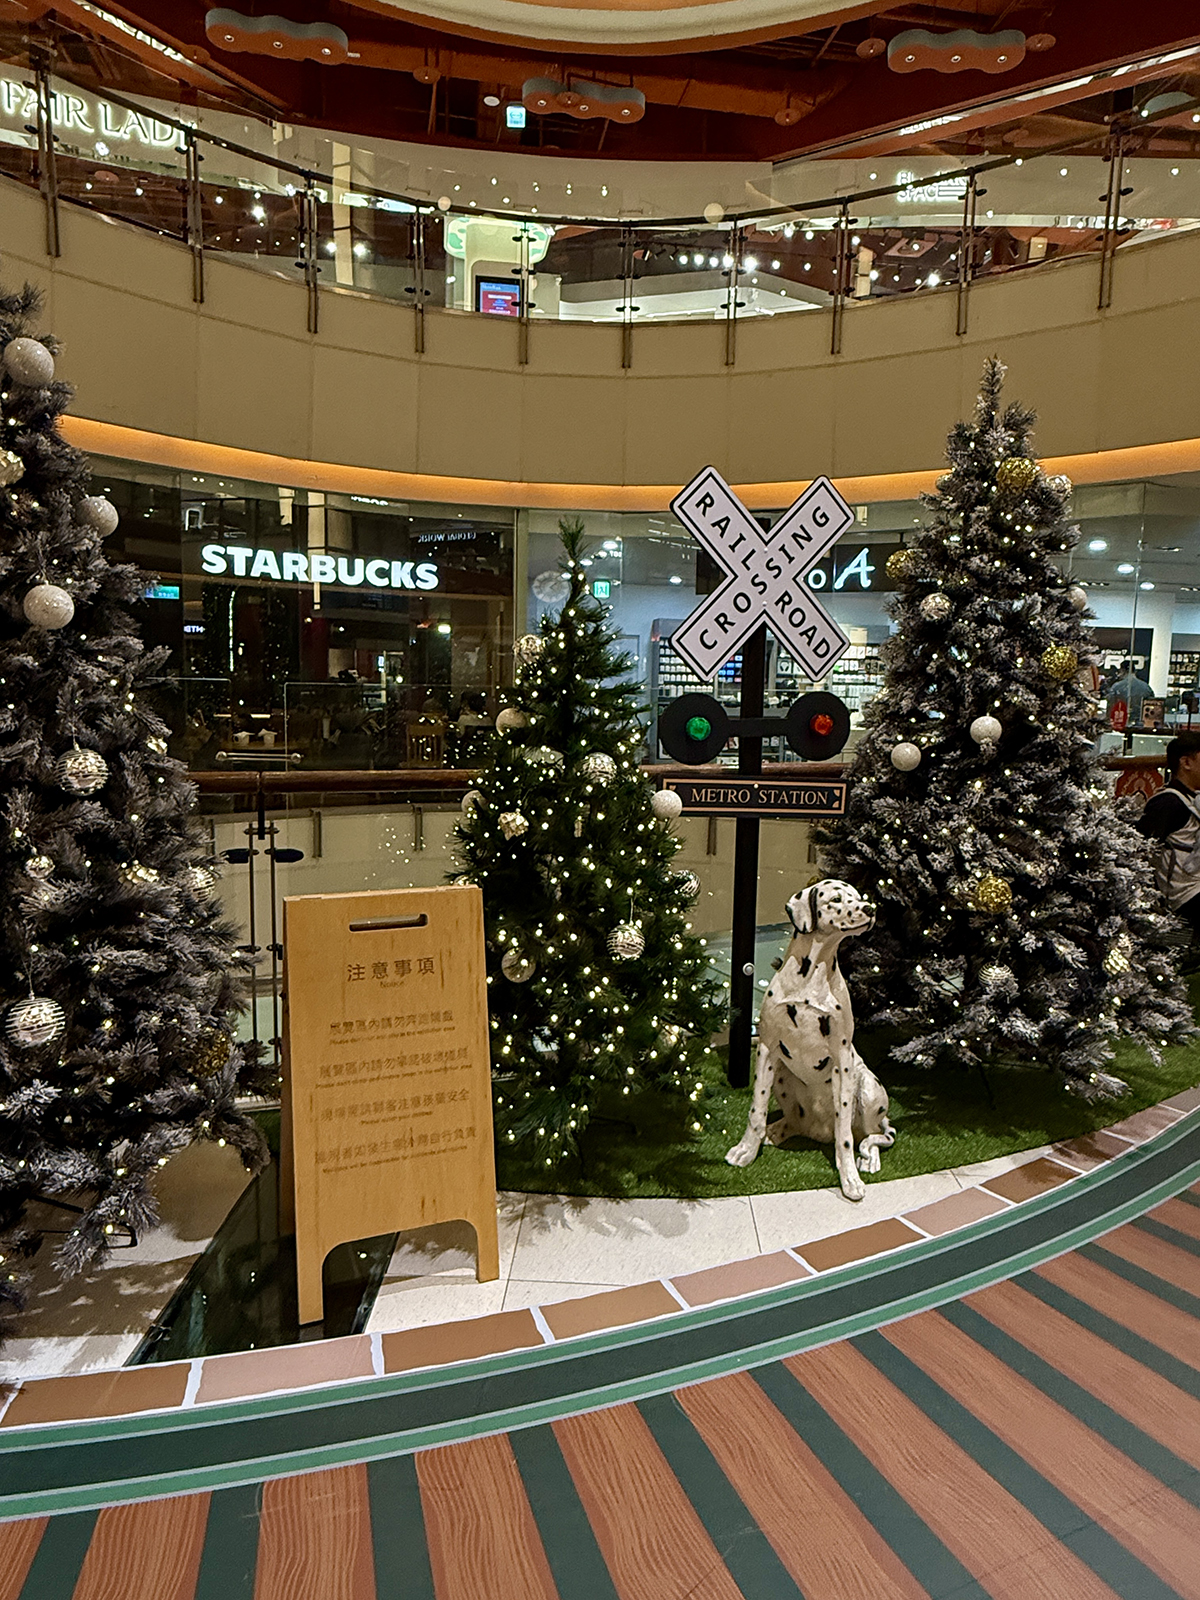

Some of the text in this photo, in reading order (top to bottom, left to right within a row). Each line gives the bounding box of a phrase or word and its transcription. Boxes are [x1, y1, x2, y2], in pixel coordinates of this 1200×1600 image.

[1, 79, 188, 150] FAIR LAD
[201, 544, 439, 590] STARBUCKS
[696, 492, 831, 659] RAIL ROAD
[699, 505, 831, 651] CROSSING
[691, 788, 829, 805] METRO STATION
[347, 957, 436, 983] 注意事項
